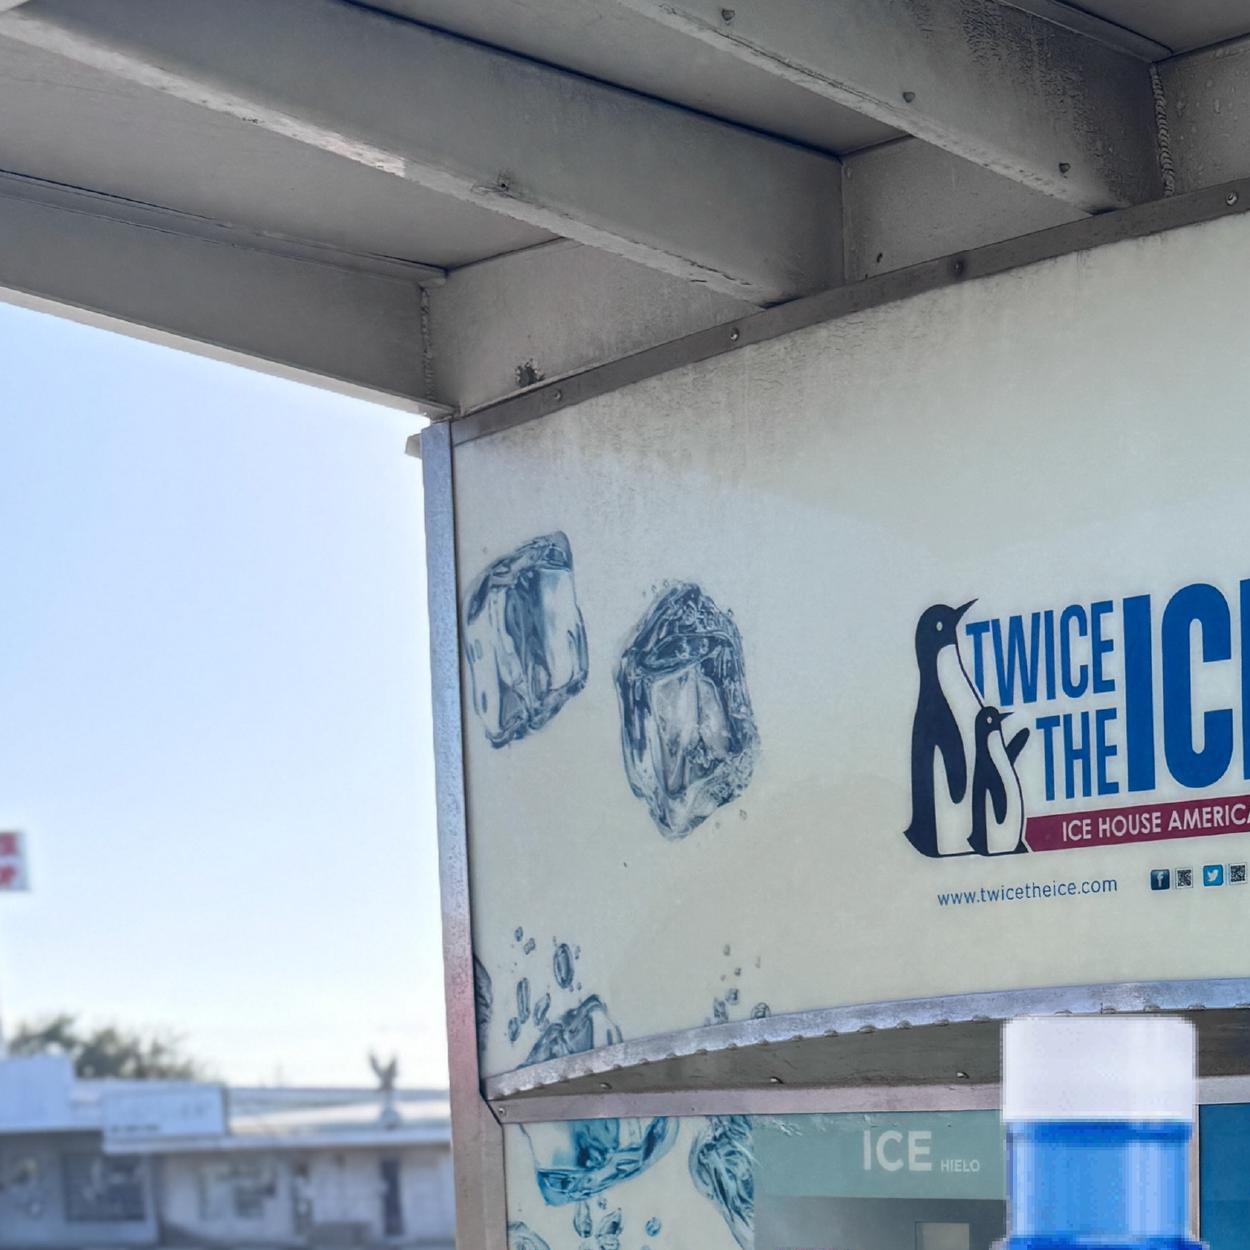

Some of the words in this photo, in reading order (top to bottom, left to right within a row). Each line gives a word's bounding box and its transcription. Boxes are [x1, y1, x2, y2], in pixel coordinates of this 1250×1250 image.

[966, 600, 1115, 706] TWICE
[1036, 707, 1119, 801] THE
[1063, 819, 1091, 841] ICE
[1099, 812, 1161, 838] HOUSE
[938, 876, 1117, 906] www.twicetheice.com
[864, 1131, 932, 1171] ICE
[941, 1159, 980, 1173] HIELO
